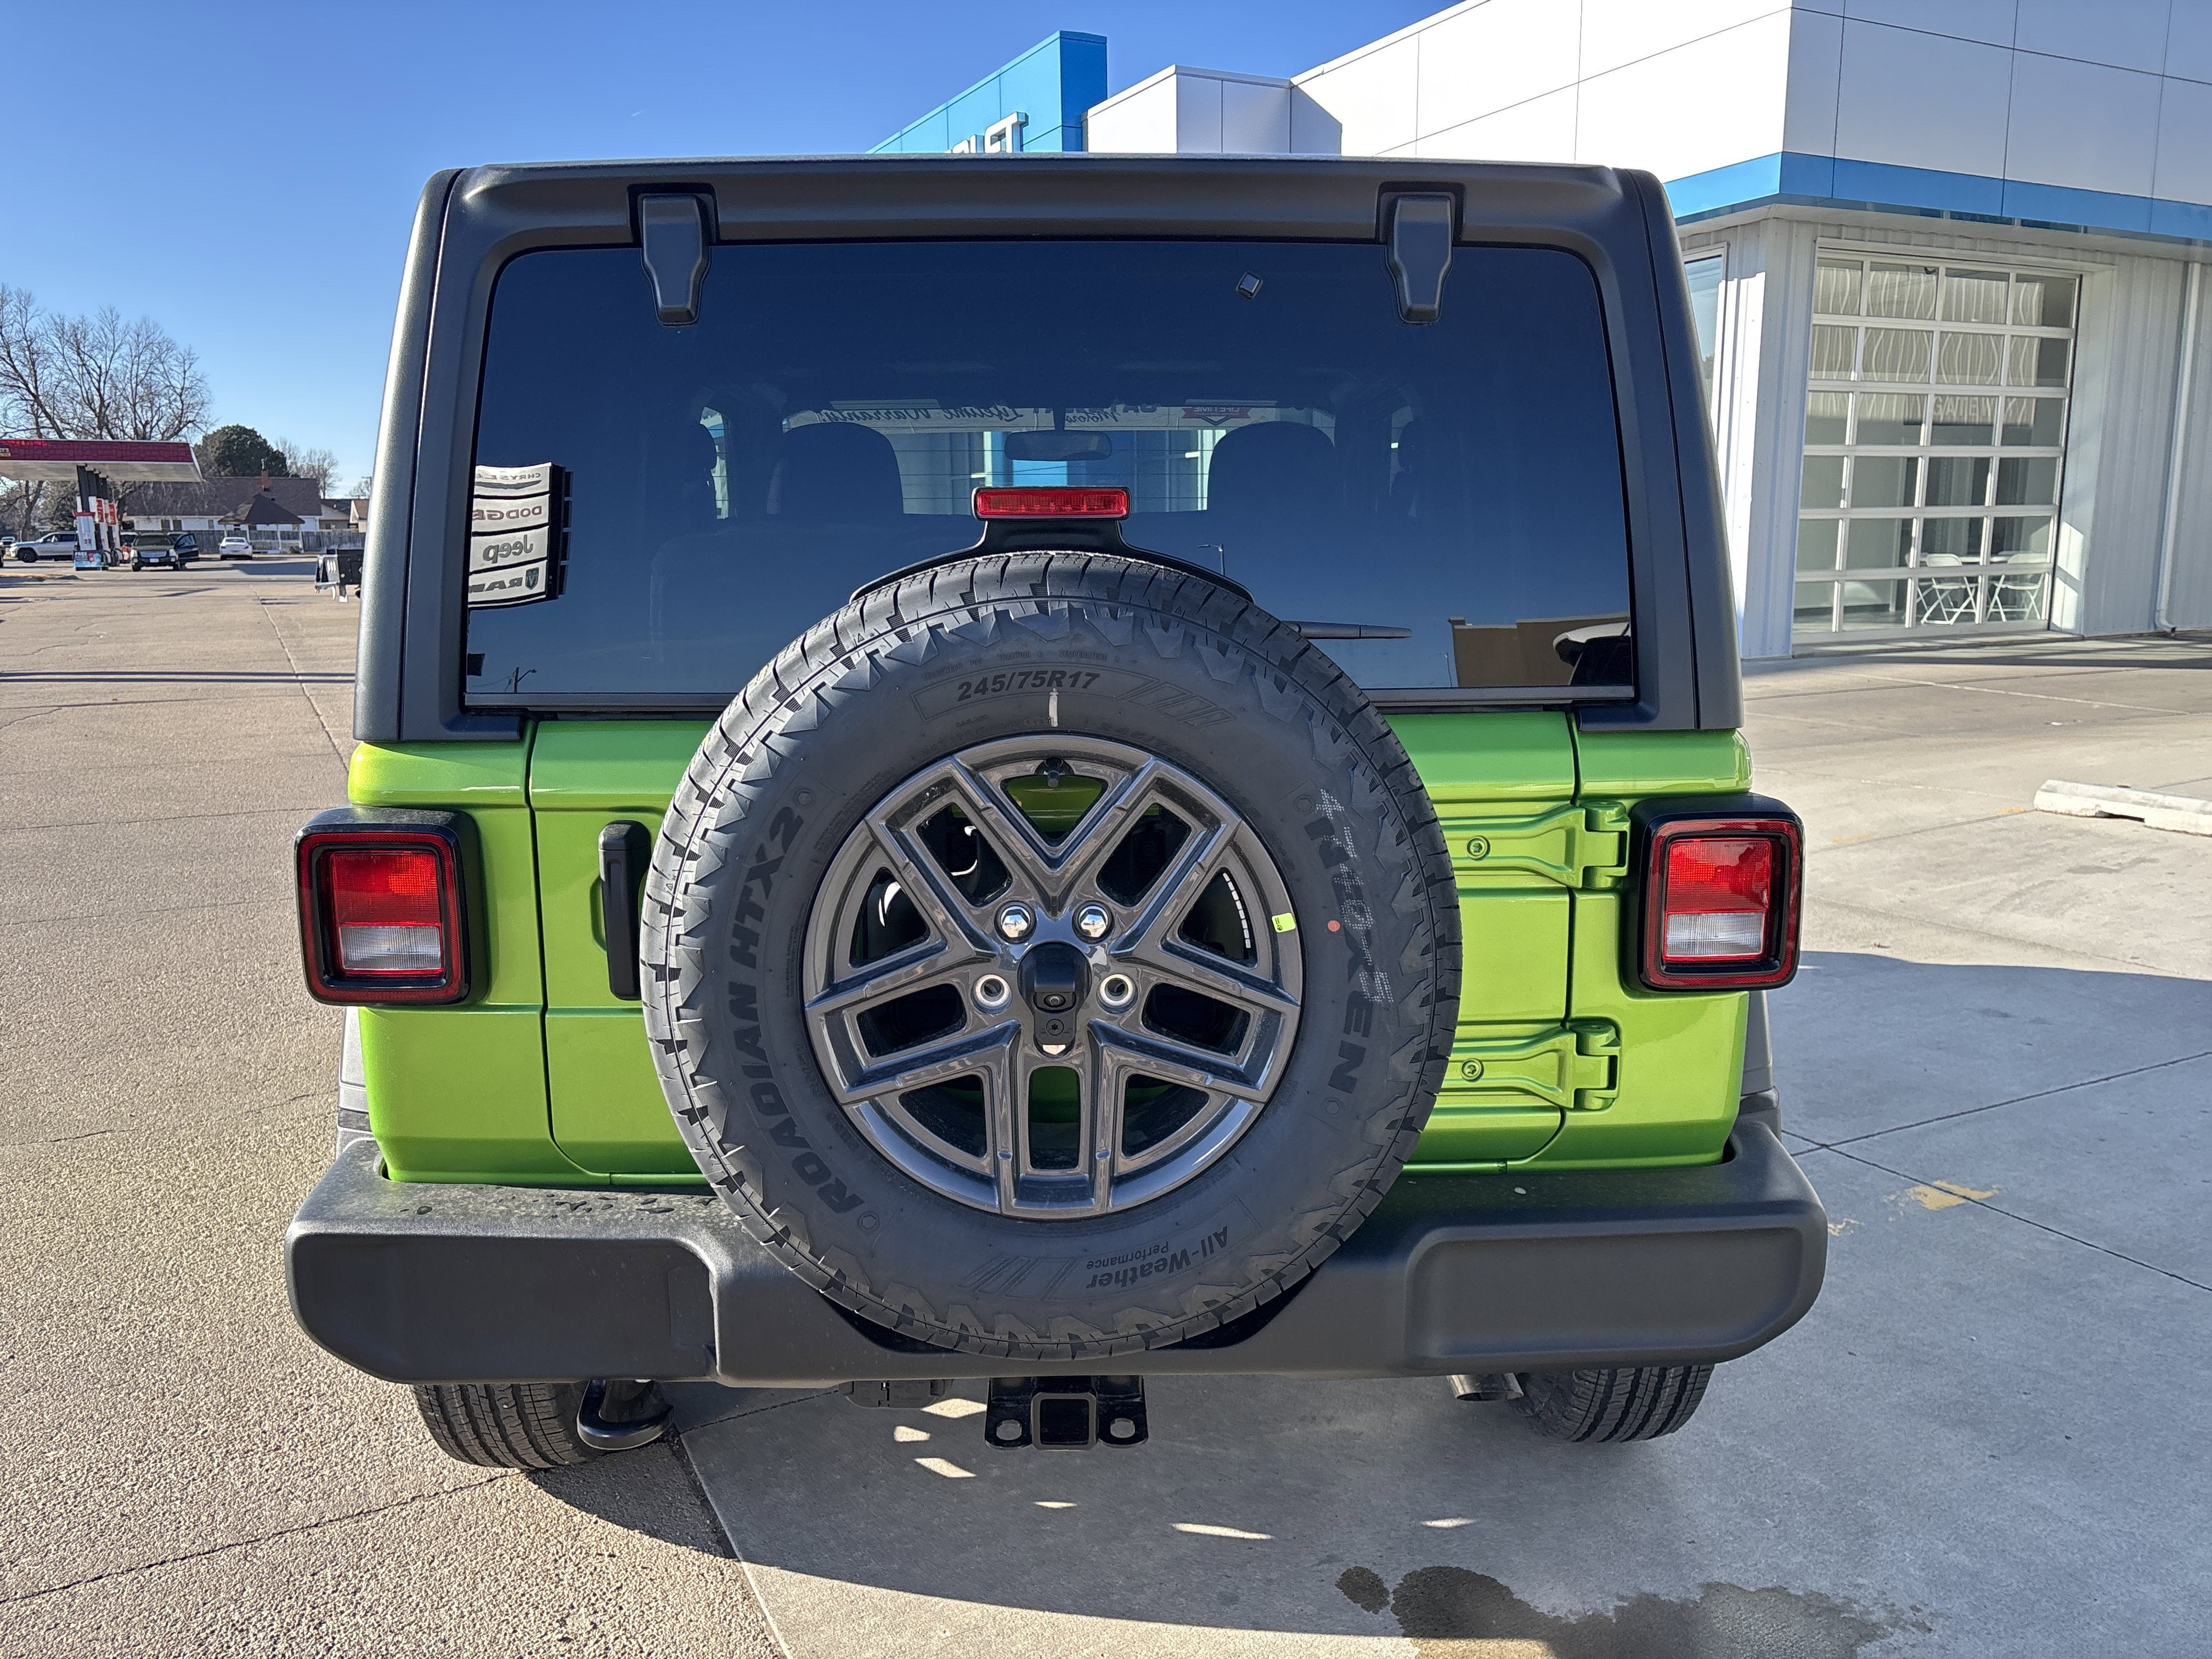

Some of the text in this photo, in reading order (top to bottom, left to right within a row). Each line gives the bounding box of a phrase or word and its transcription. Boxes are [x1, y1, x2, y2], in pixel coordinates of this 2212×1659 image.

[957, 670, 1100, 701] 245/75R17
[1304, 815, 1374, 1093] NEXEN
[729, 806, 866, 1214] ROADIAN HTX2
[1086, 1240, 1170, 1270] Performance
[1086, 1226, 1229, 1290] All-Weather
